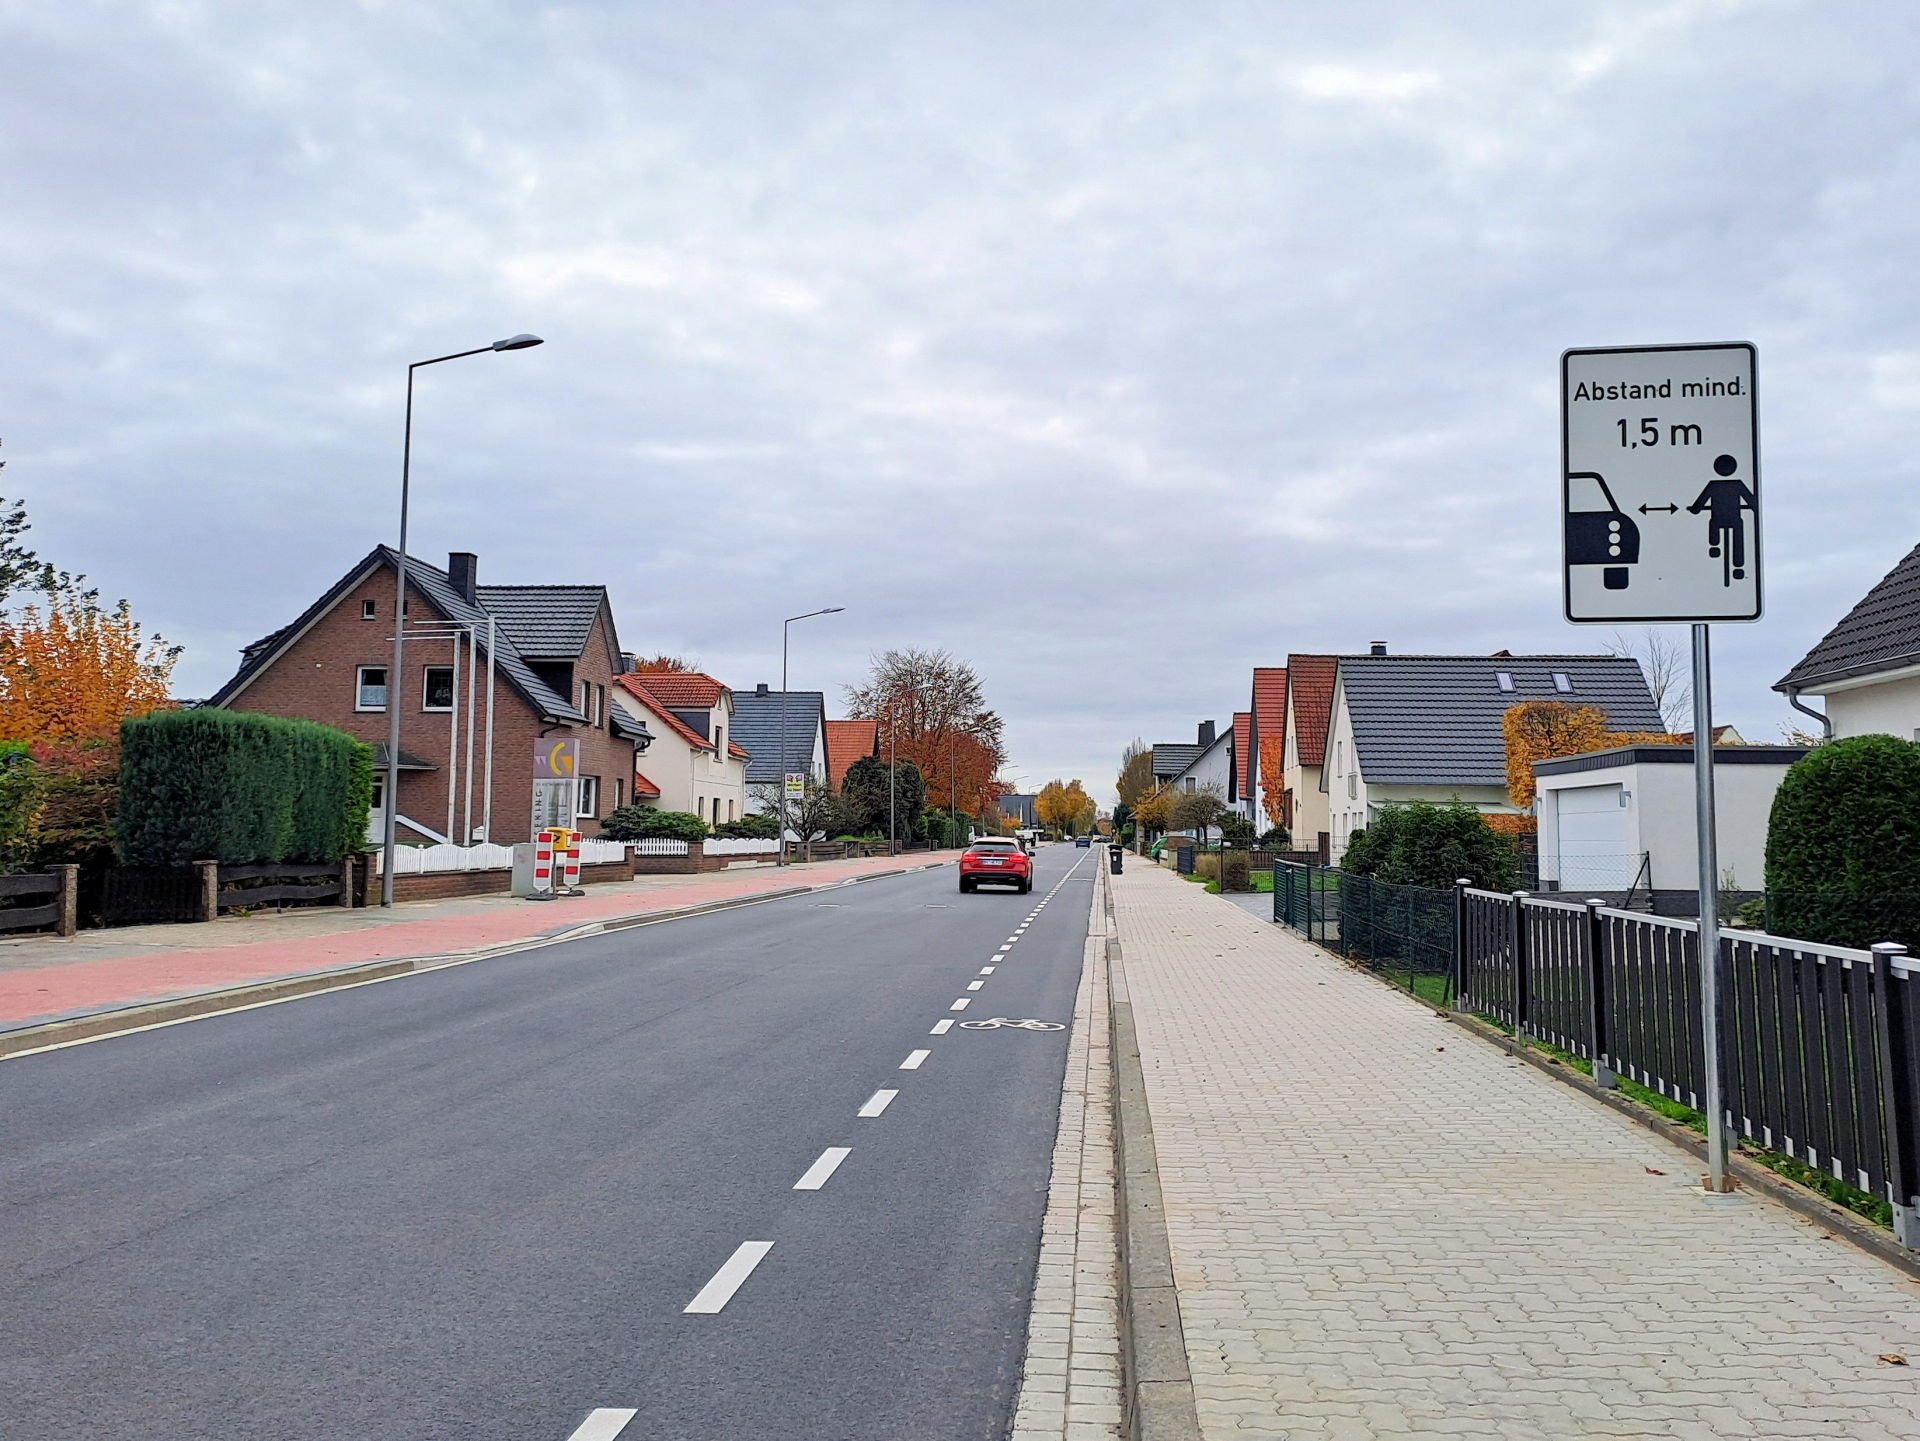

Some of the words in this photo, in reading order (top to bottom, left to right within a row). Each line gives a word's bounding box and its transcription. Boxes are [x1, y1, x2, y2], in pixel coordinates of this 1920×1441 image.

[1574, 379, 1671, 401] Abstand
[1682, 376, 1746, 397] mind.
[1617, 417, 1659, 449] 1,5
[1671, 424, 1702, 446] m
